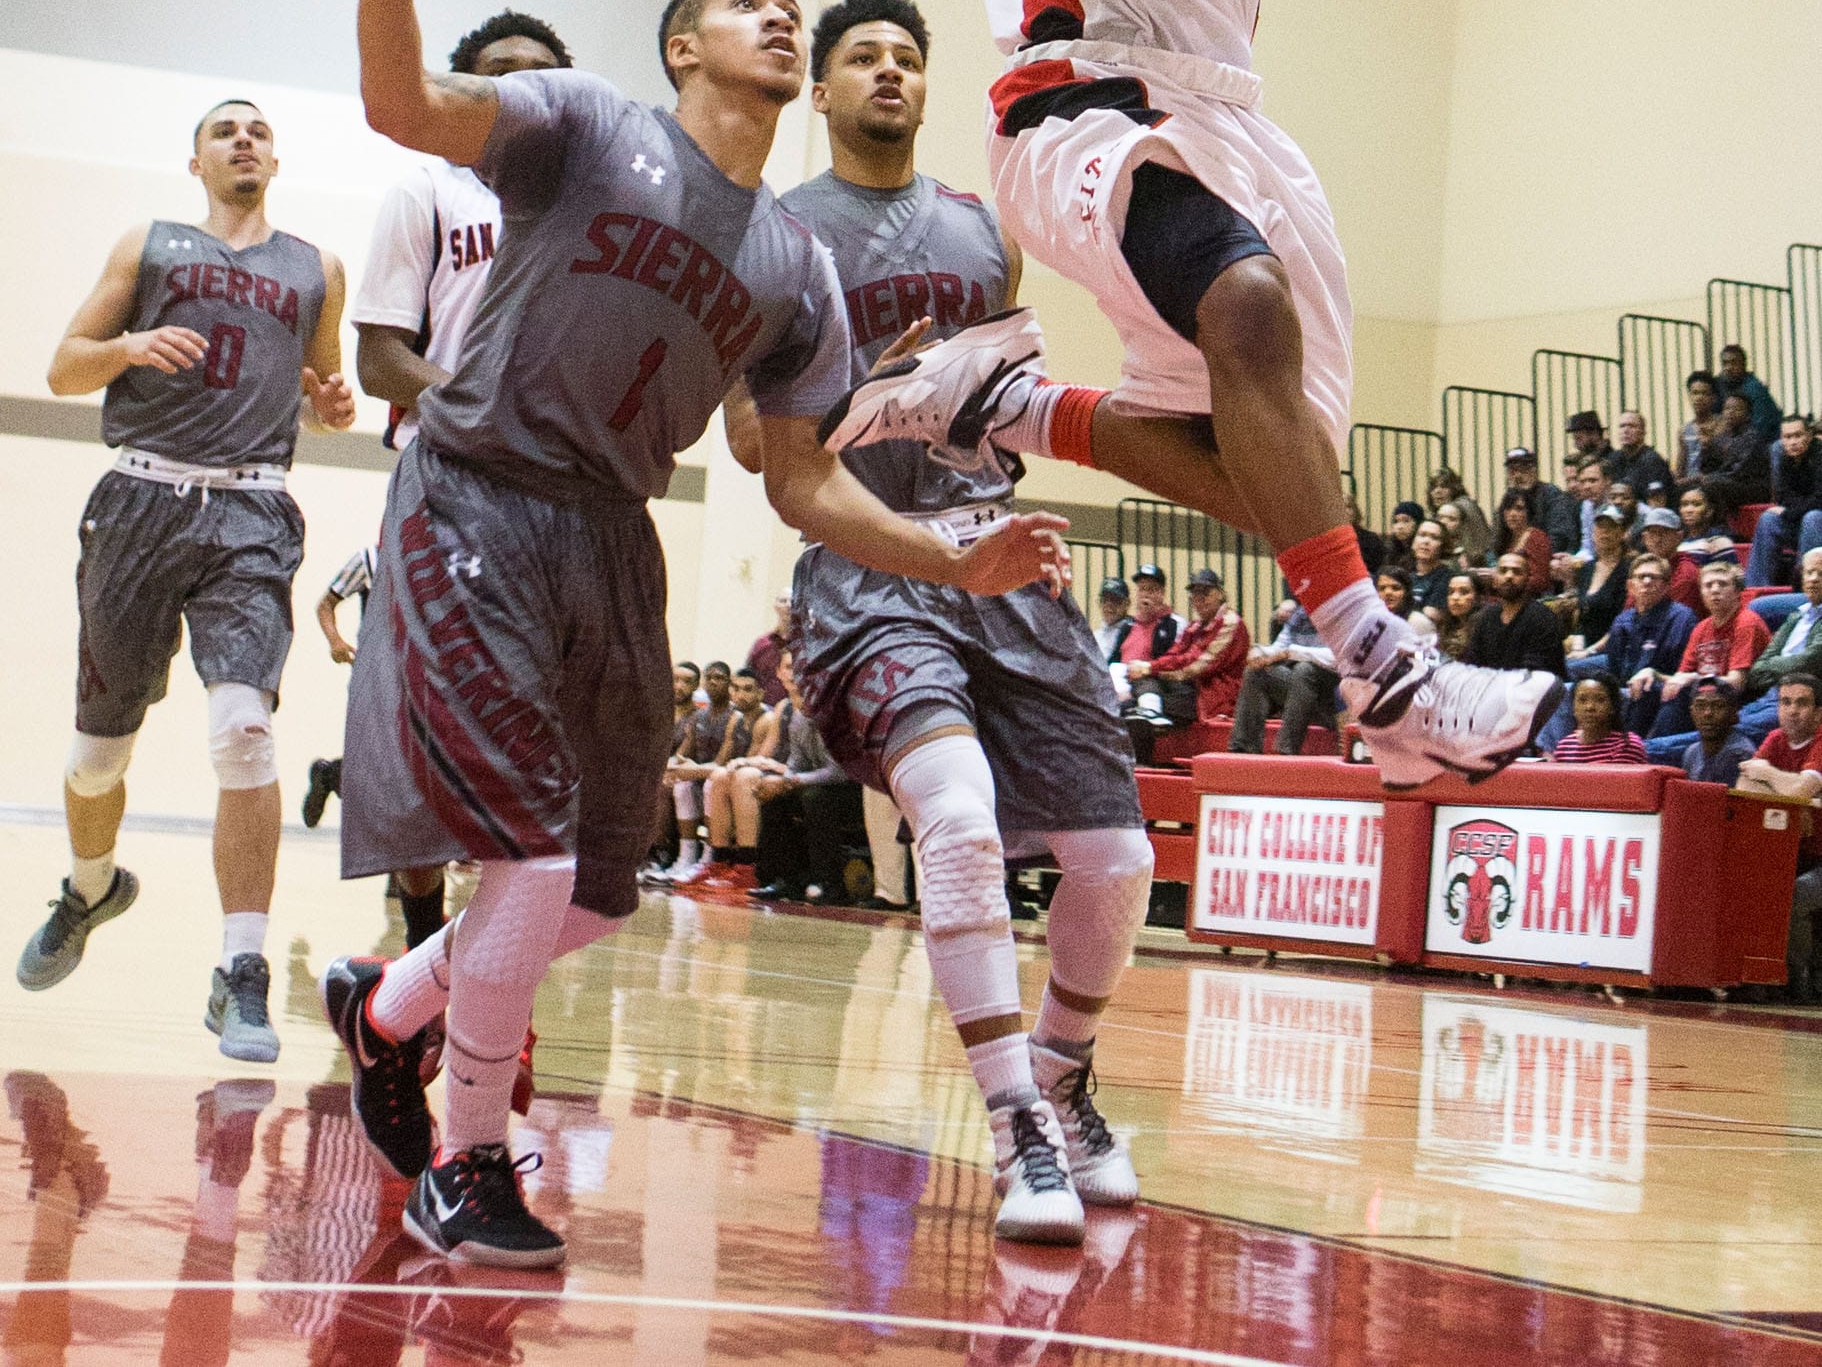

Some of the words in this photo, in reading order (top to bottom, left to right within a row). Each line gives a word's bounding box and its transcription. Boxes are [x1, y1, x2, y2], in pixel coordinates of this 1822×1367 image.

[450, 222, 494, 271] SAN
[165, 262, 299, 336] SIERRA
[570, 211, 763, 381] SIERRA
[844, 271, 986, 347] IERRA
[204, 321, 246, 390] 0
[607, 336, 668, 432] 1
[1208, 807, 1253, 857] CITY
[1261, 810, 1348, 865] COLLEGE
[1356, 814, 1385, 868] OF
[1207, 866, 1248, 919] SAN
[1254, 870, 1372, 930] FRANCISCO
[1520, 833, 1644, 940] RAMS
